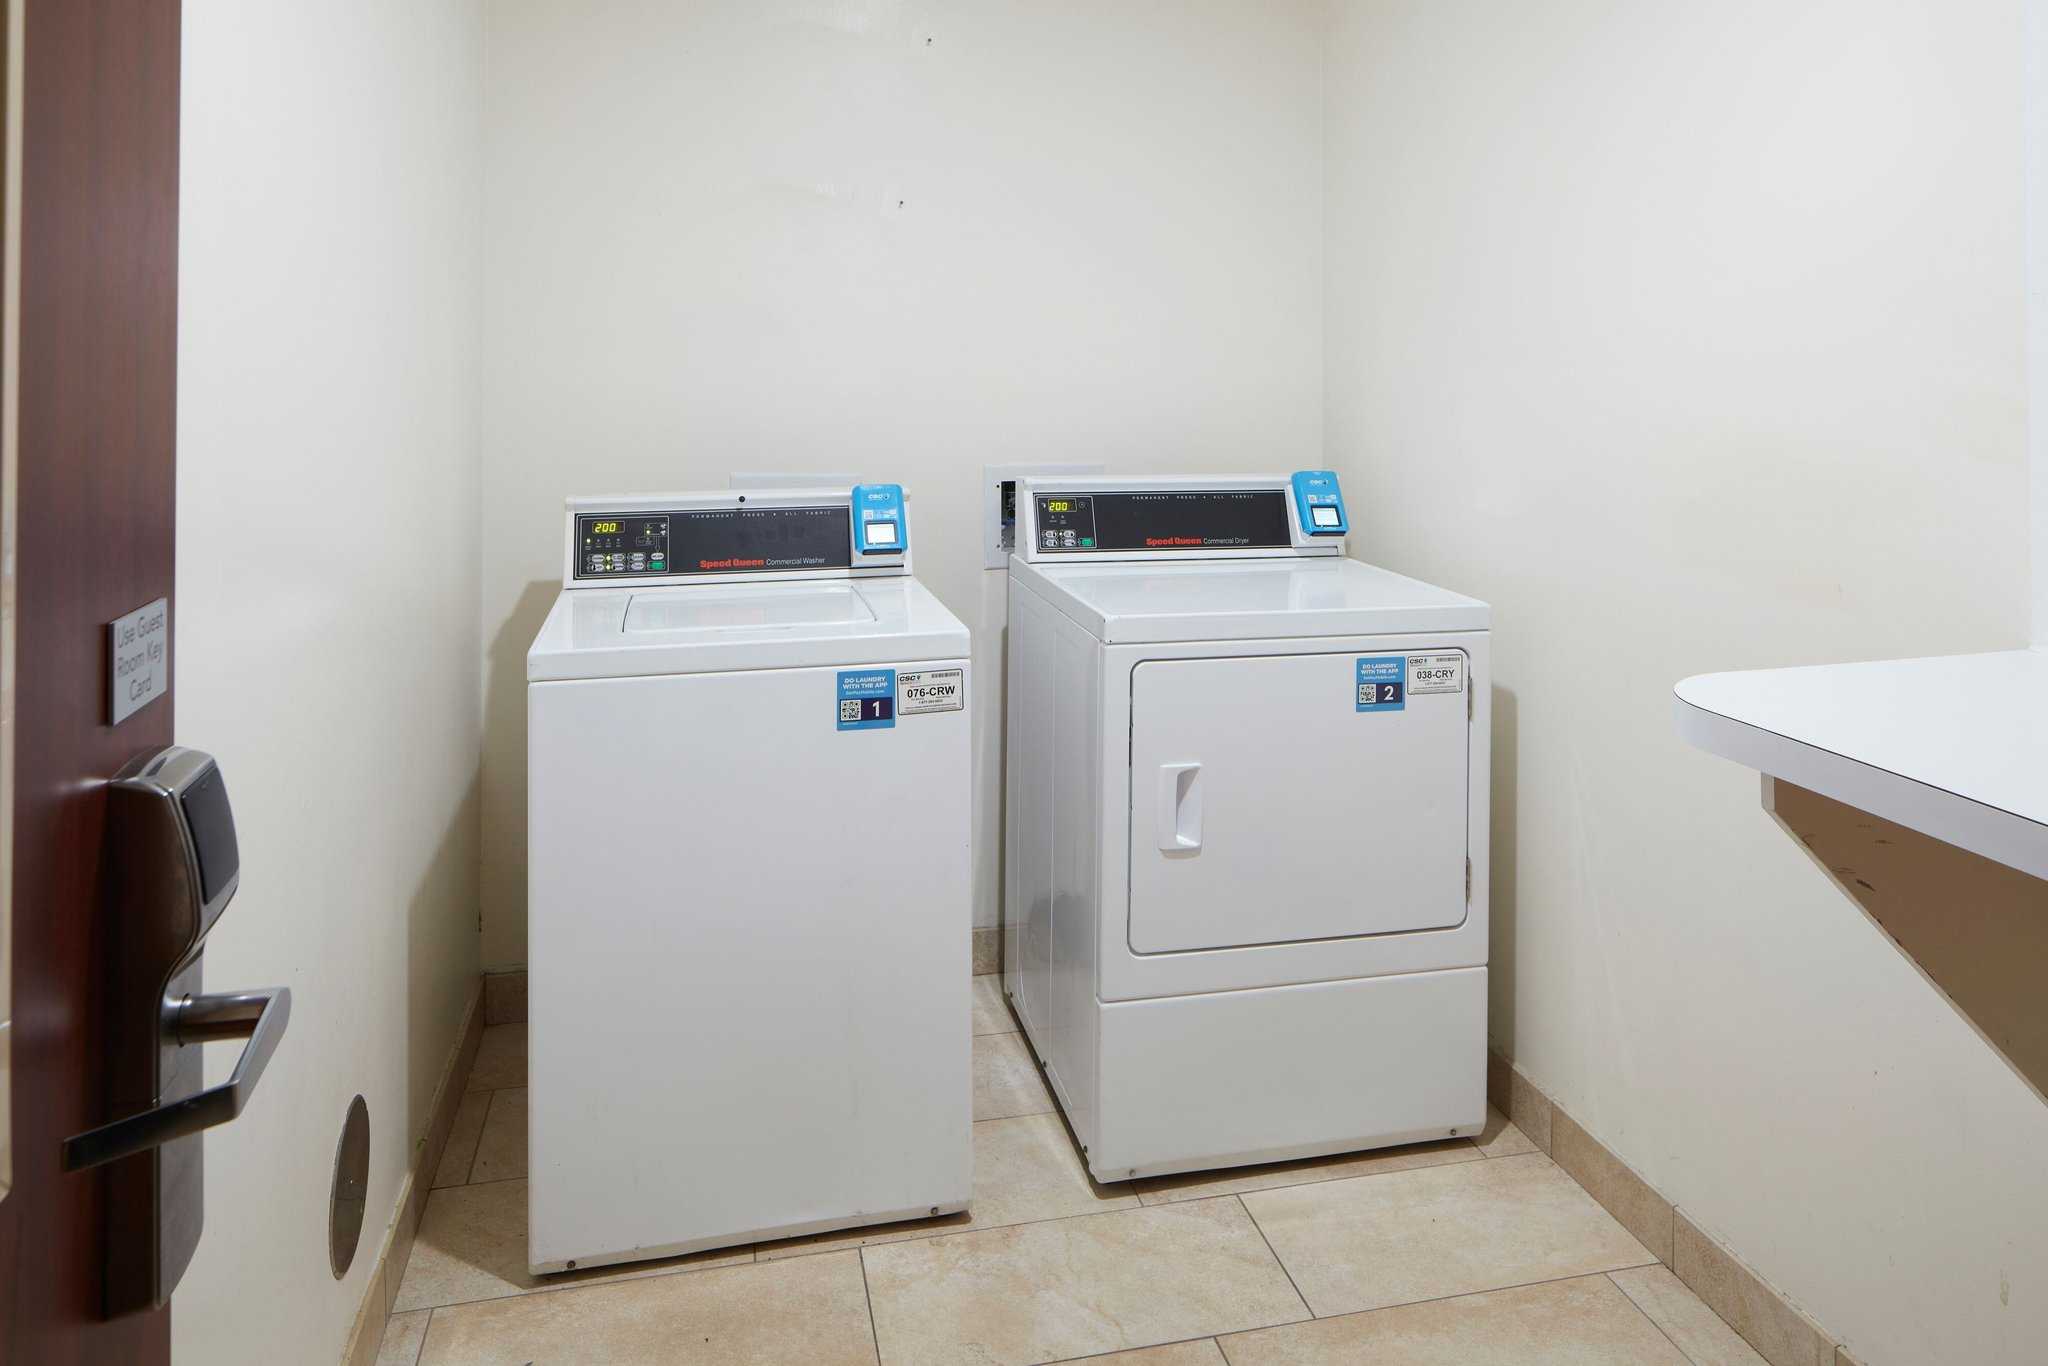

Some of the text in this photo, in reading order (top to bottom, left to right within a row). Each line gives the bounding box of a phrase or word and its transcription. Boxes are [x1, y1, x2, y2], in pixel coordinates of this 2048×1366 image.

[1049, 502, 1068, 511] 200
[594, 523, 617, 533] 200
[1146, 537, 1174, 546] Speed
[1174, 536, 1202, 544] Queen
[1234, 537, 1249, 545] Dryer
[700, 557, 825, 569] Speed Queen Commercial Washer
[117, 610, 163, 649] Use Guest
[117, 640, 163, 678] Room Key
[1416, 669, 1455, 680] 038-CRY
[129, 670, 152, 701] Card
[907, 685, 956, 698] 076-CRW
[1384, 685, 1394, 701] 2
[872, 701, 880, 717] 1
